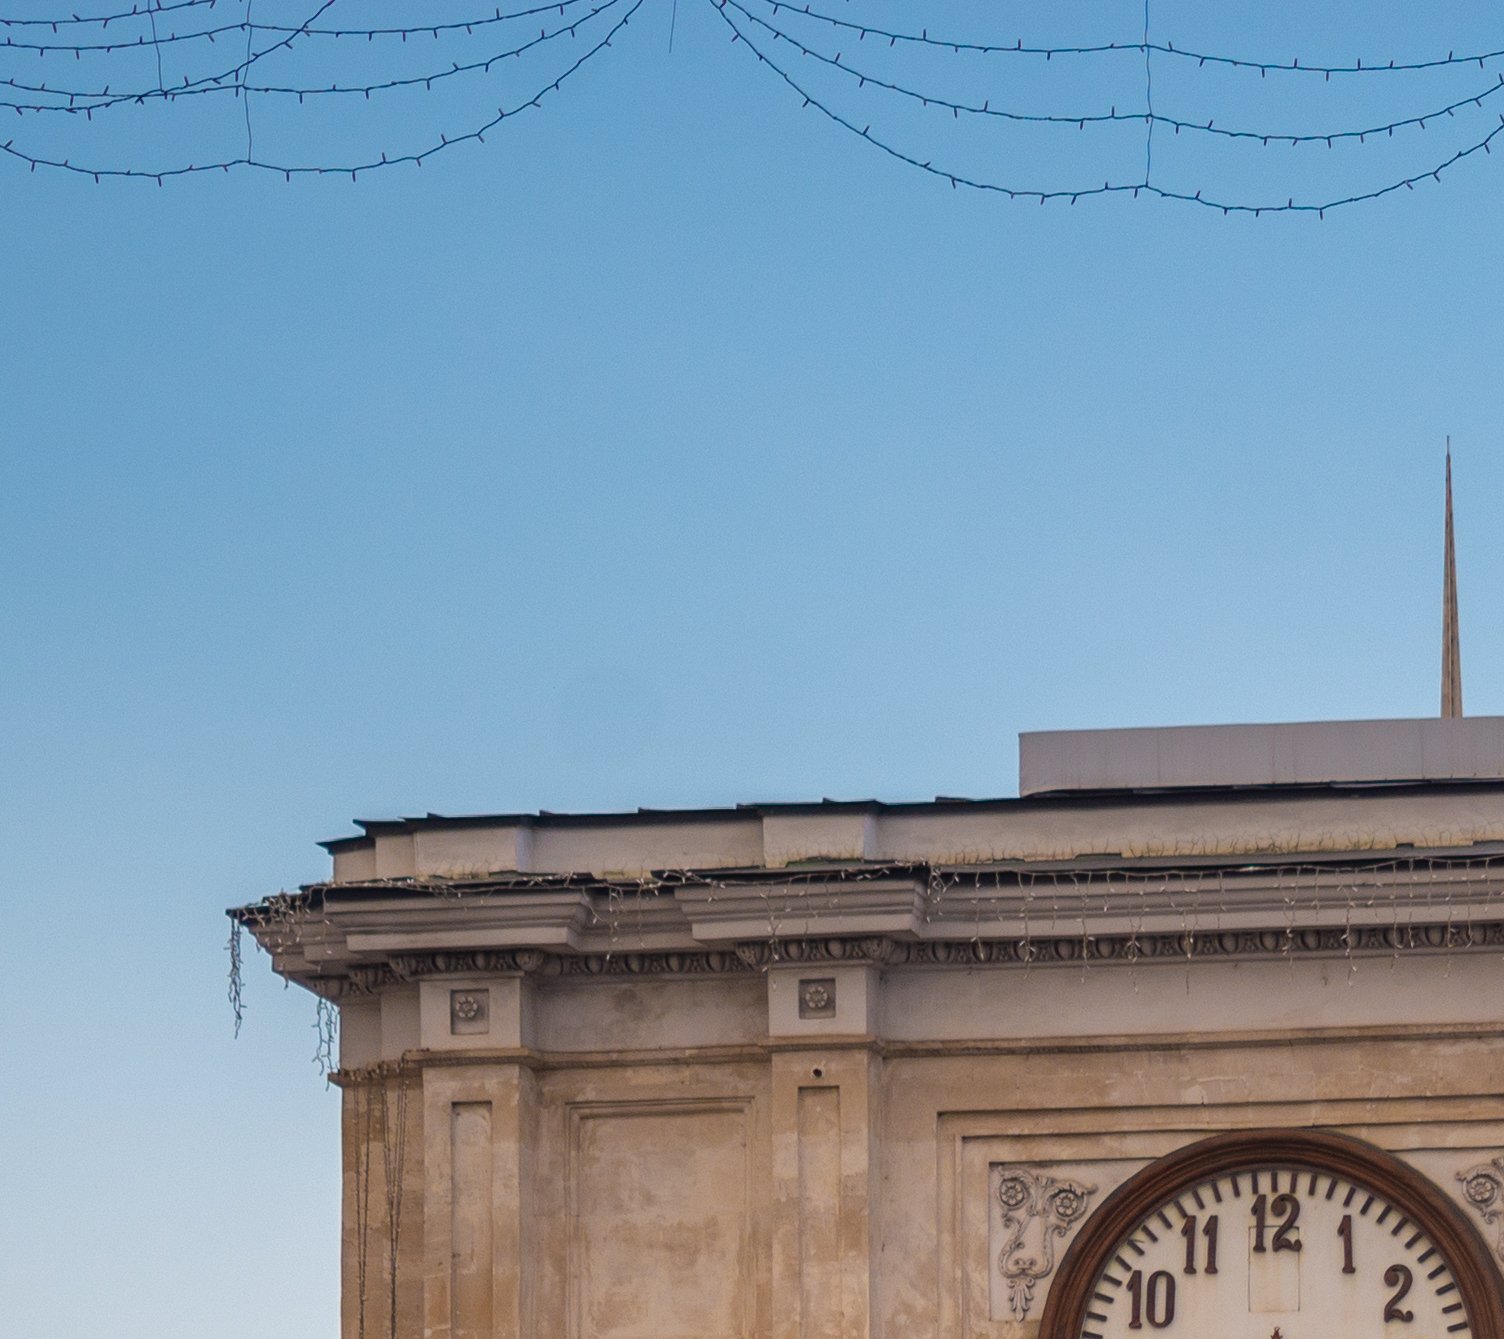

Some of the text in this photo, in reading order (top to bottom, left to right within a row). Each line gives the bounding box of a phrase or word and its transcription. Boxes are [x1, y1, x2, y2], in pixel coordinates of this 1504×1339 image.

[1181, 1215, 1218, 1274] 11
[1251, 1193, 1302, 1253] 12
[1337, 1214, 1356, 1274] 1
[1126, 1270, 1176, 1329] 10
[1384, 1264, 1414, 1323] 2
